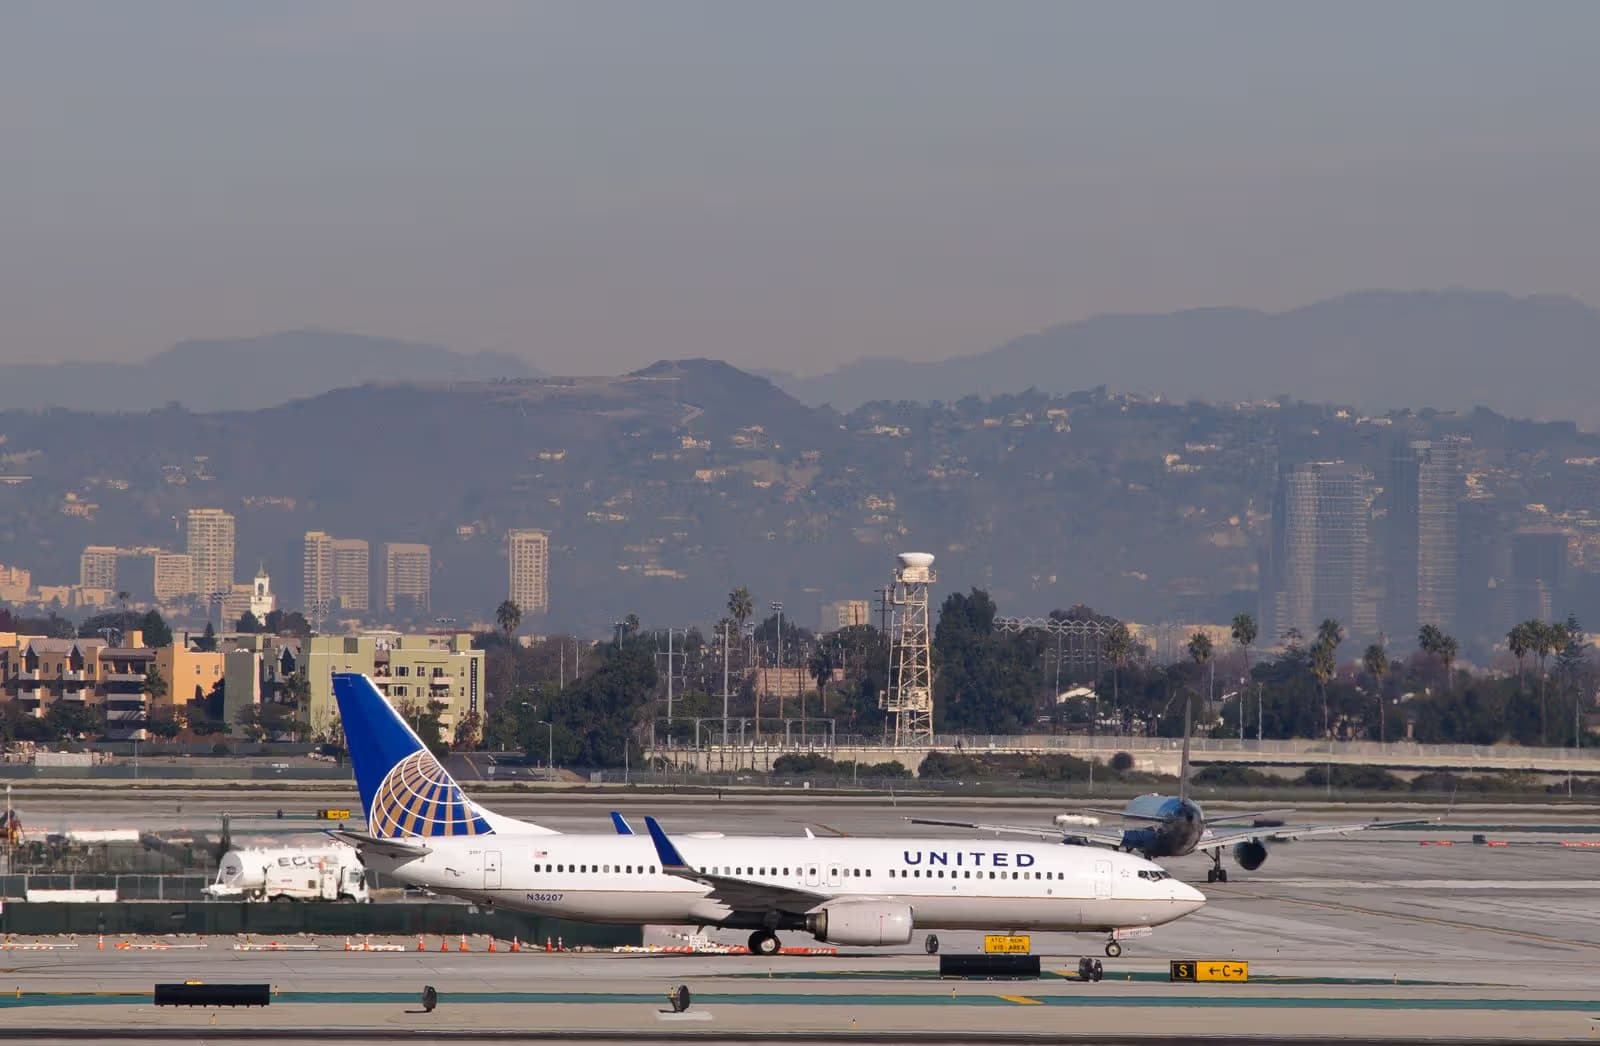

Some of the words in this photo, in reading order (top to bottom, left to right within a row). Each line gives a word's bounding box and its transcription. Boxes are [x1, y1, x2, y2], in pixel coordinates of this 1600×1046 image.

[903, 850, 1035, 867] UNITED
[526, 893, 564, 901] N36207
[1179, 965, 1188, 977] S
[1222, 965, 1231, 977] C
